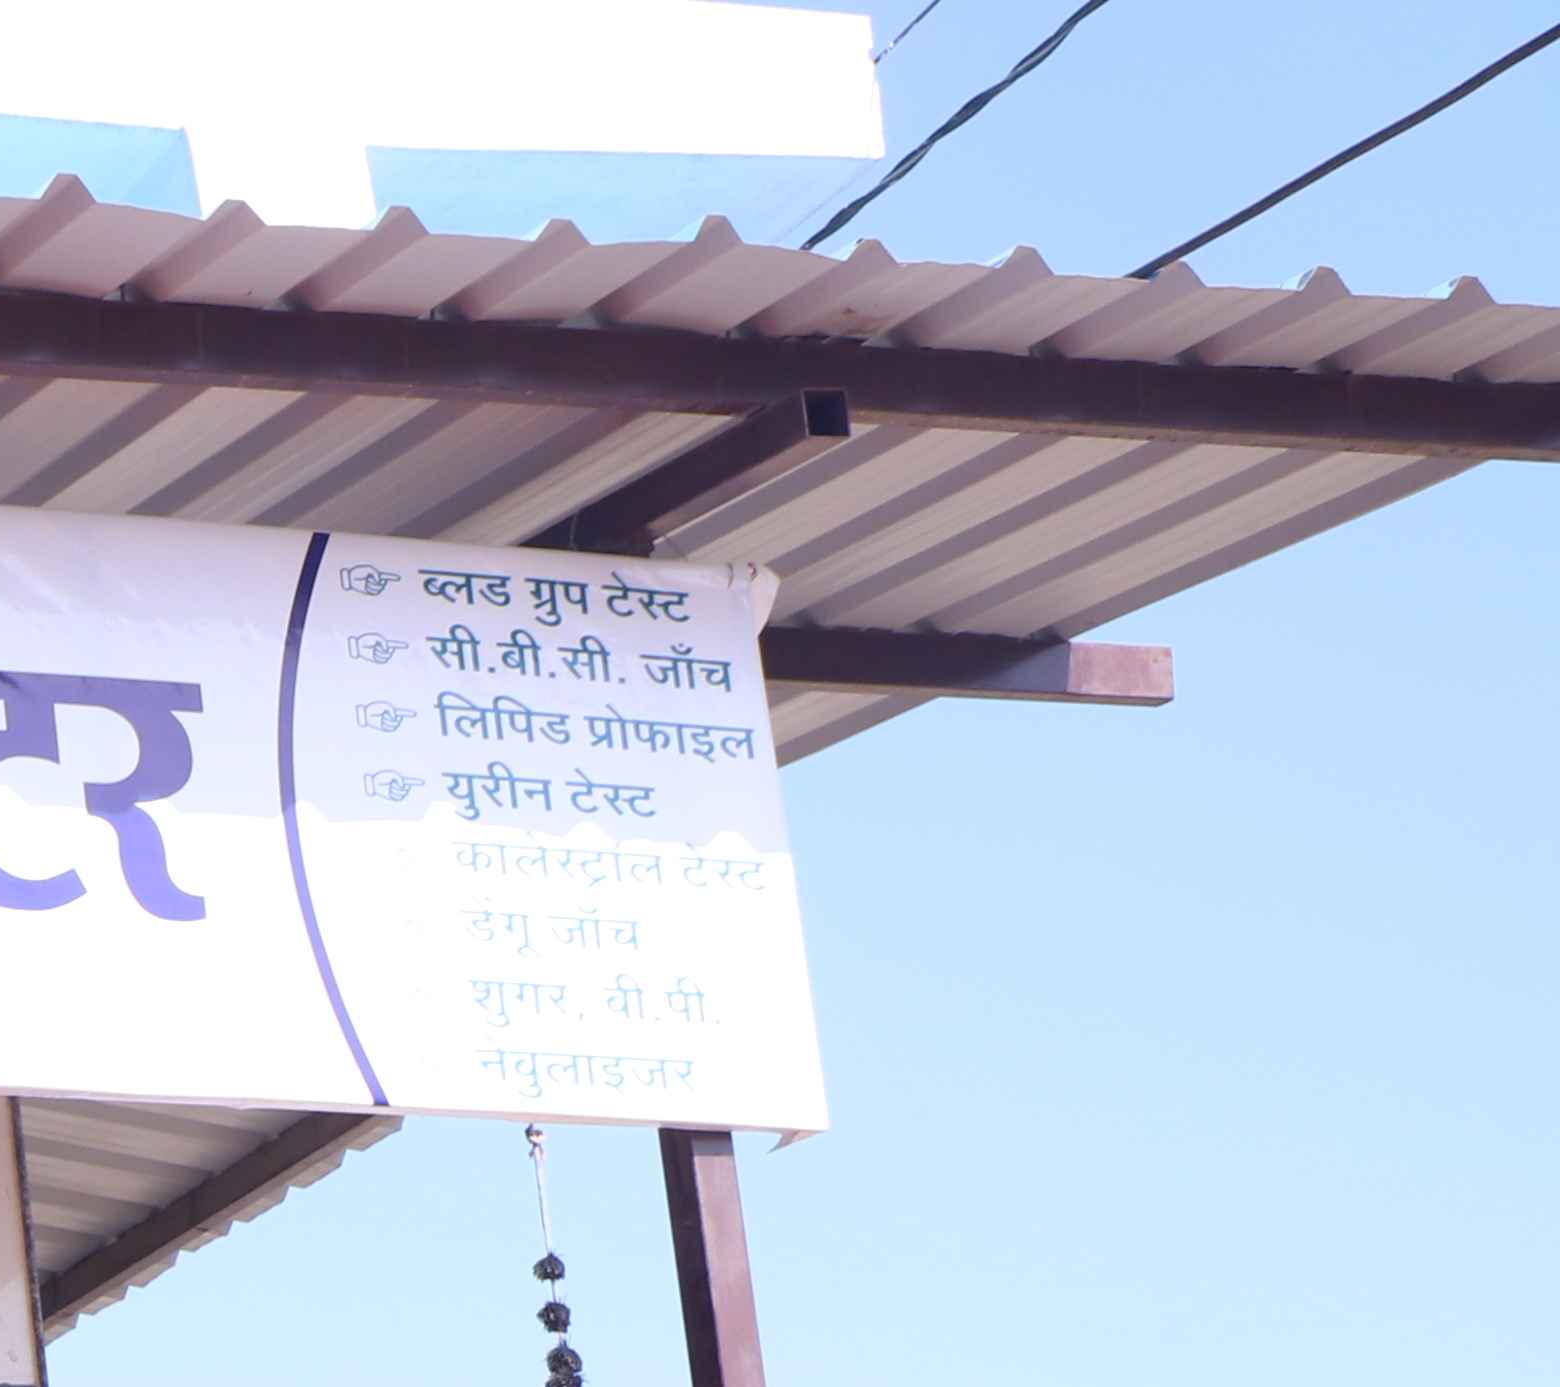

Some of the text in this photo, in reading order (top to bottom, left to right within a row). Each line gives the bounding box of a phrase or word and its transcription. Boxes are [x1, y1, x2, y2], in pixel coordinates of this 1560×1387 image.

[417, 568, 691, 627] ब्लड ग्रुप टेस्ट
[434, 691, 755, 764] लिपिड प्रोफाइल
[442, 760, 657, 821] युरीन टेस्ट
